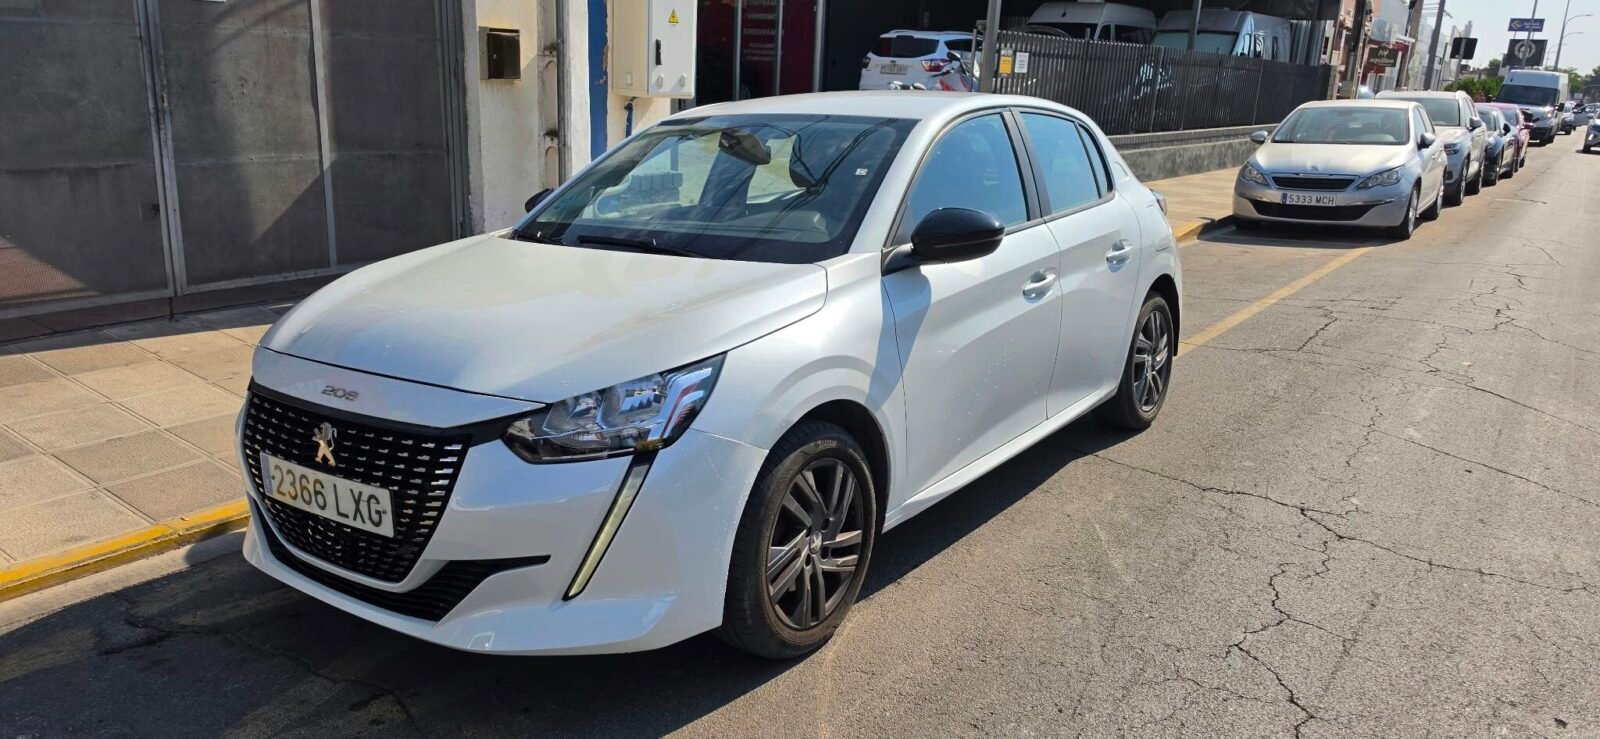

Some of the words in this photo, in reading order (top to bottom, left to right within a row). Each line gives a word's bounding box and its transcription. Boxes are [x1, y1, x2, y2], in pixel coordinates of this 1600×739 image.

[1289, 194, 1312, 203] 5333
[1316, 196, 1335, 205] MCH
[321, 385, 360, 401] 208
[273, 464, 327, 511] 2366
[333, 483, 384, 528] LXG
